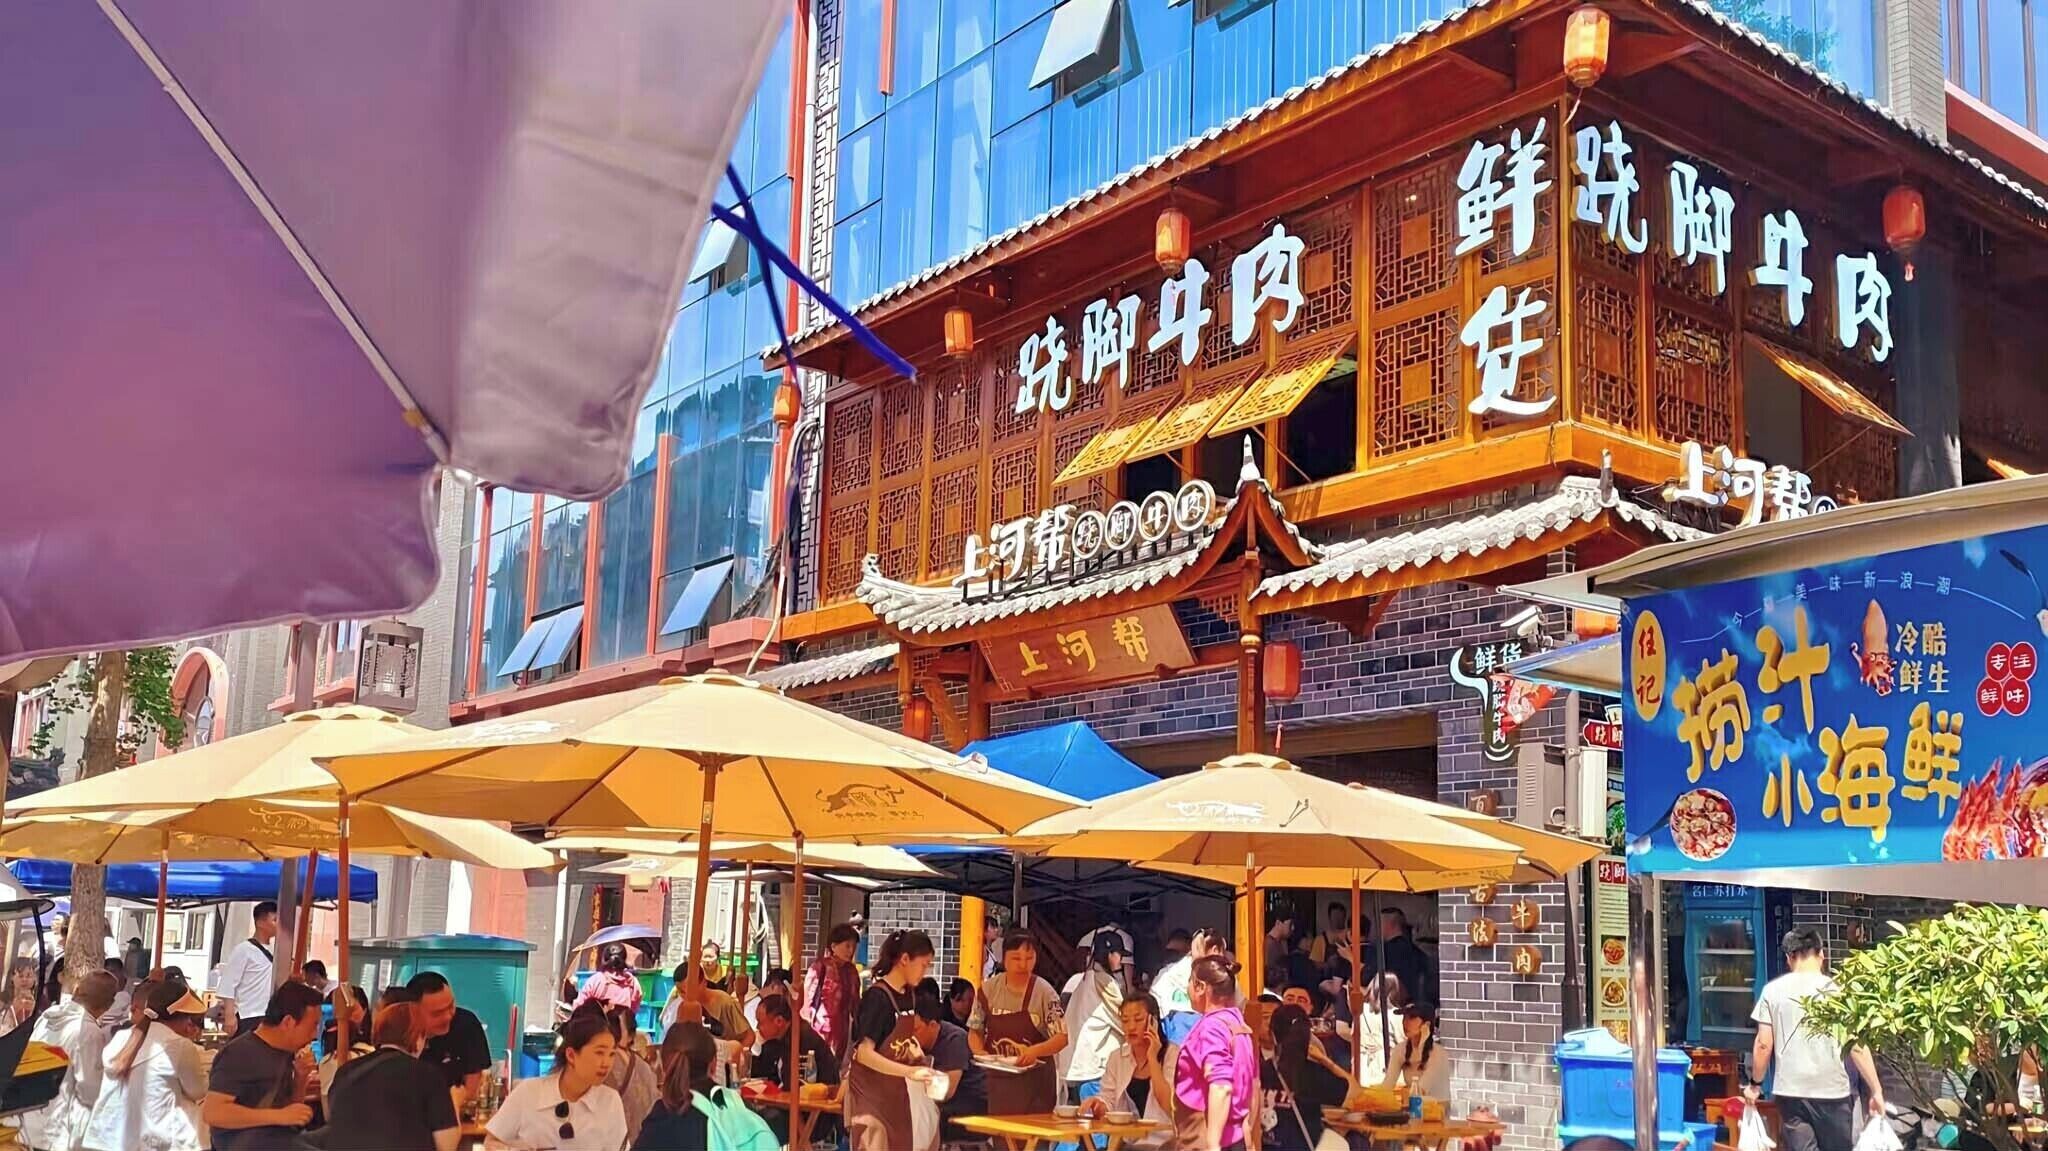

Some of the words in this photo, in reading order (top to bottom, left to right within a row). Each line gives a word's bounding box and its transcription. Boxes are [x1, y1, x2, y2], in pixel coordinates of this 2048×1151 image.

[1573, 119, 1895, 362] 跷脚牛肉
[1015, 223, 1307, 414] 跷脚牛肉
[1667, 440, 1812, 529] 上河帮
[952, 504, 1077, 588] 上河帮
[1019, 616, 1150, 677] 上河帮
[1474, 643, 1523, 675] 鲜货
[1636, 625, 1660, 705] 任记
[1895, 621, 1947, 656] 冷酷
[1899, 660, 1950, 694] 鲜生
[1990, 653, 2032, 671] 专注
[1672, 606, 1830, 783] 捞汁
[1981, 688, 2025, 704] 鲜味
[1763, 702, 1964, 843] 小海鲜
